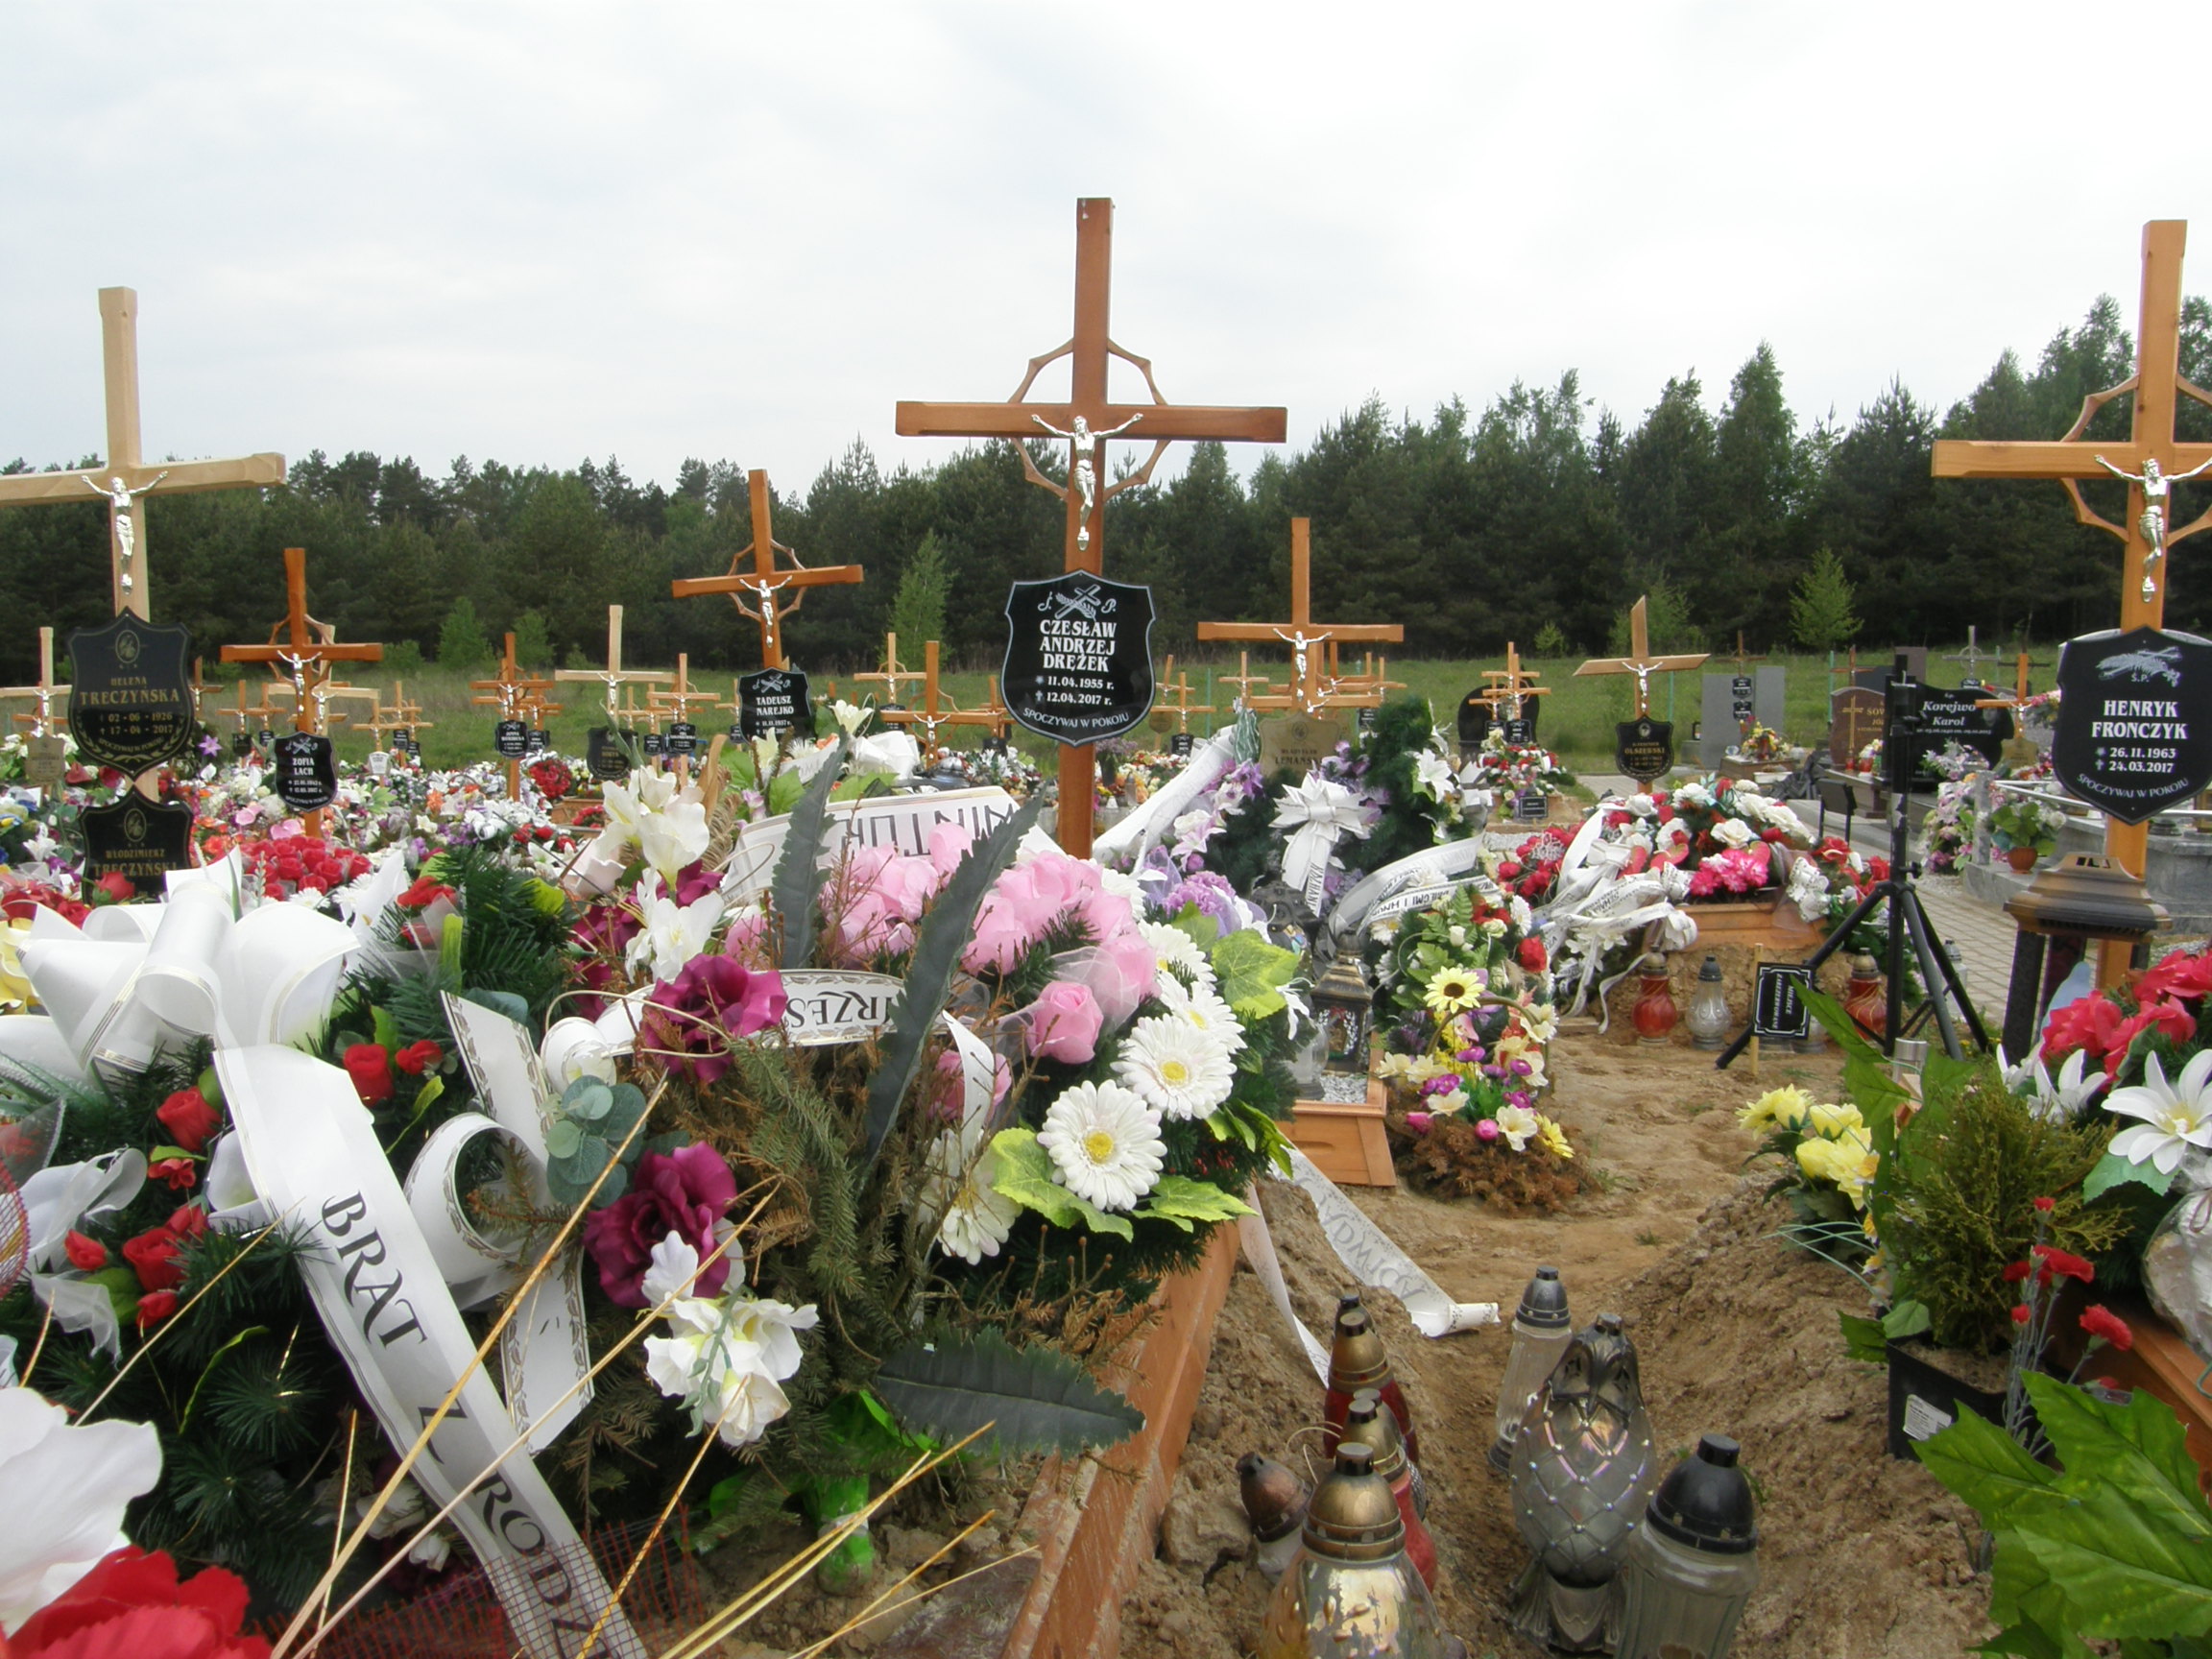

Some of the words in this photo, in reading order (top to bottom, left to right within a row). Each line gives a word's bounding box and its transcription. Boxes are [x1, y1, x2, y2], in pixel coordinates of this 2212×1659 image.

[1040, 619, 1117, 637] CZESŁAW
[1039, 636, 1116, 656] ANDRZEJ
[1043, 653, 1109, 672] DRĘŻEK
[110, 676, 148, 686] HELENA
[1047, 676, 1103, 689] 11.04.1955
[1106, 682, 1115, 690] r.
[756, 695, 792, 706] TADEUSZ
[1046, 691, 1101, 706] 12.04.2017
[1104, 697, 1112, 706] r.
[1923, 701, 1976, 714] Korejwo
[2104, 700, 2178, 717] HENRYK
[1022, 708, 1078, 728] SPOCZYWAJ
[1080, 719, 1092, 728] W
[1092, 712, 1130, 728] POKOJU
[1933, 716, 1965, 726] Karol
[293, 757, 315, 766] ZOFIA
[2108, 760, 2174, 773] 24.03.2017
[2077, 773, 2134, 798] SPOCZYWAJ
[2136, 789, 2147, 798] W
[2150, 778, 2189, 797] POKOJU
[1786, 984, 1794, 1015] MIEJSCE
[321, 1190, 428, 1351] BRAT
